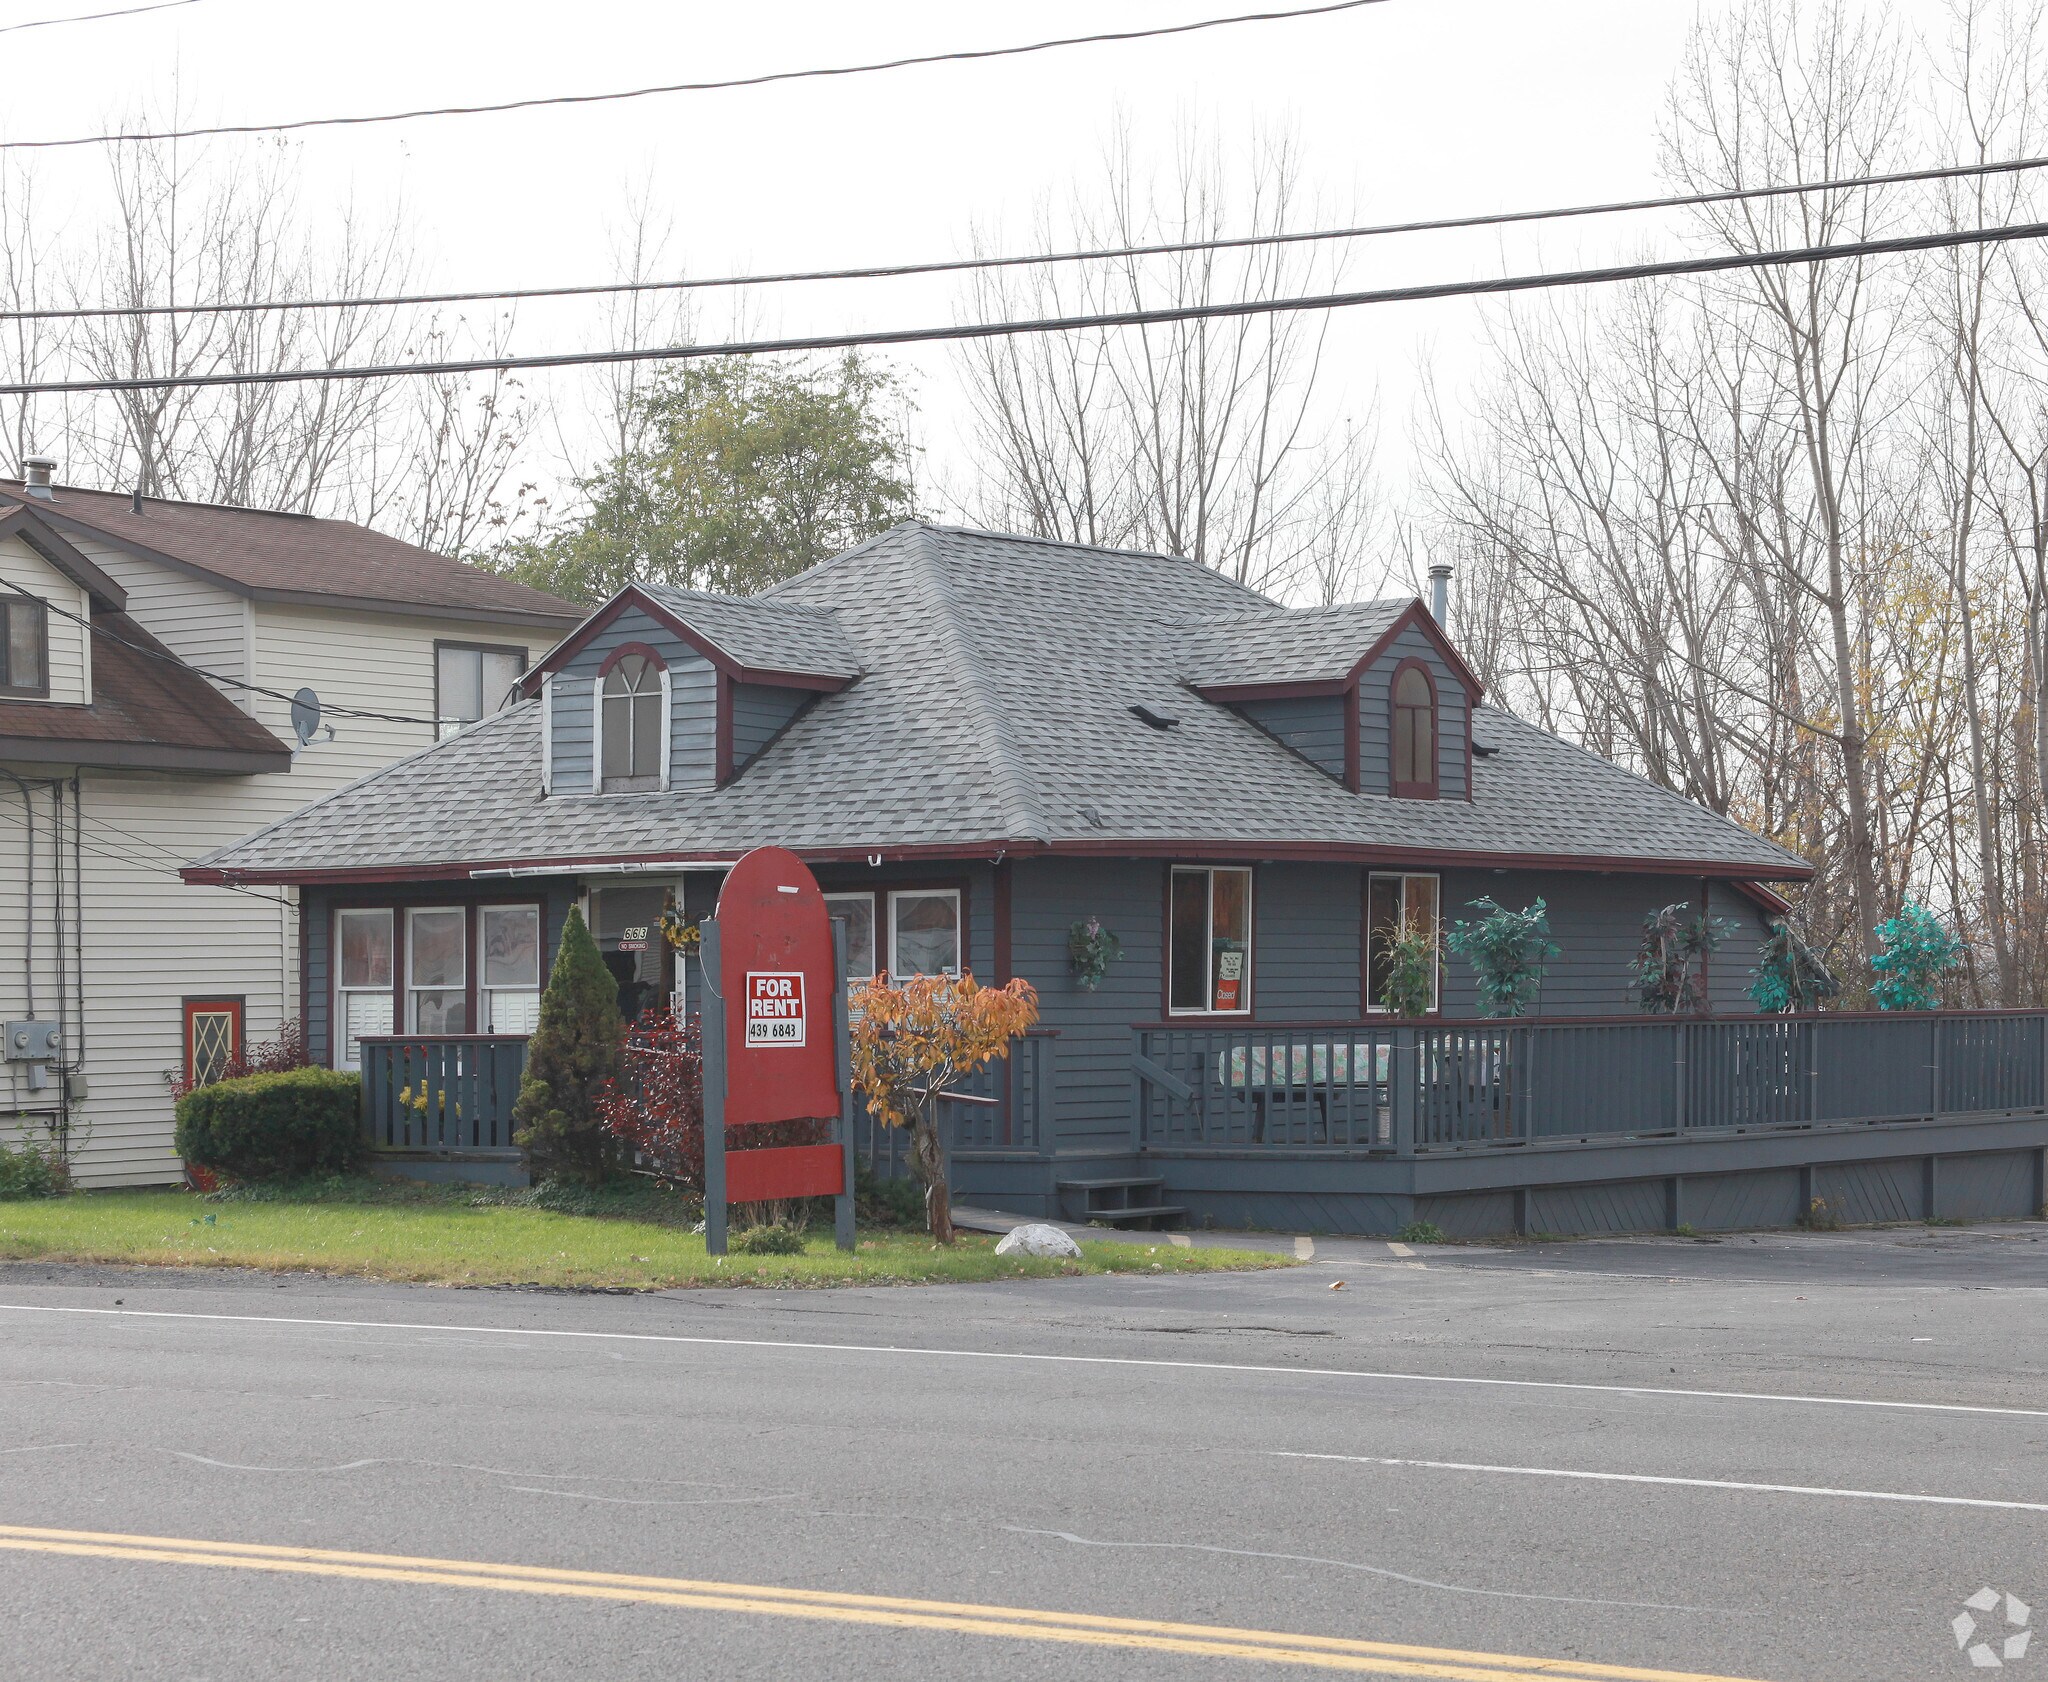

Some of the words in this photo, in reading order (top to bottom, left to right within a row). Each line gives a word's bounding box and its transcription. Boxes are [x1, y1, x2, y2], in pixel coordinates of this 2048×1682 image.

[625, 929, 646, 938] 663
[756, 979, 792, 996] FOR
[1216, 989, 1235, 999] Closed
[752, 999, 800, 1016] RENT
[750, 1024, 768, 1037] 439
[772, 1024, 796, 1037] 6843
